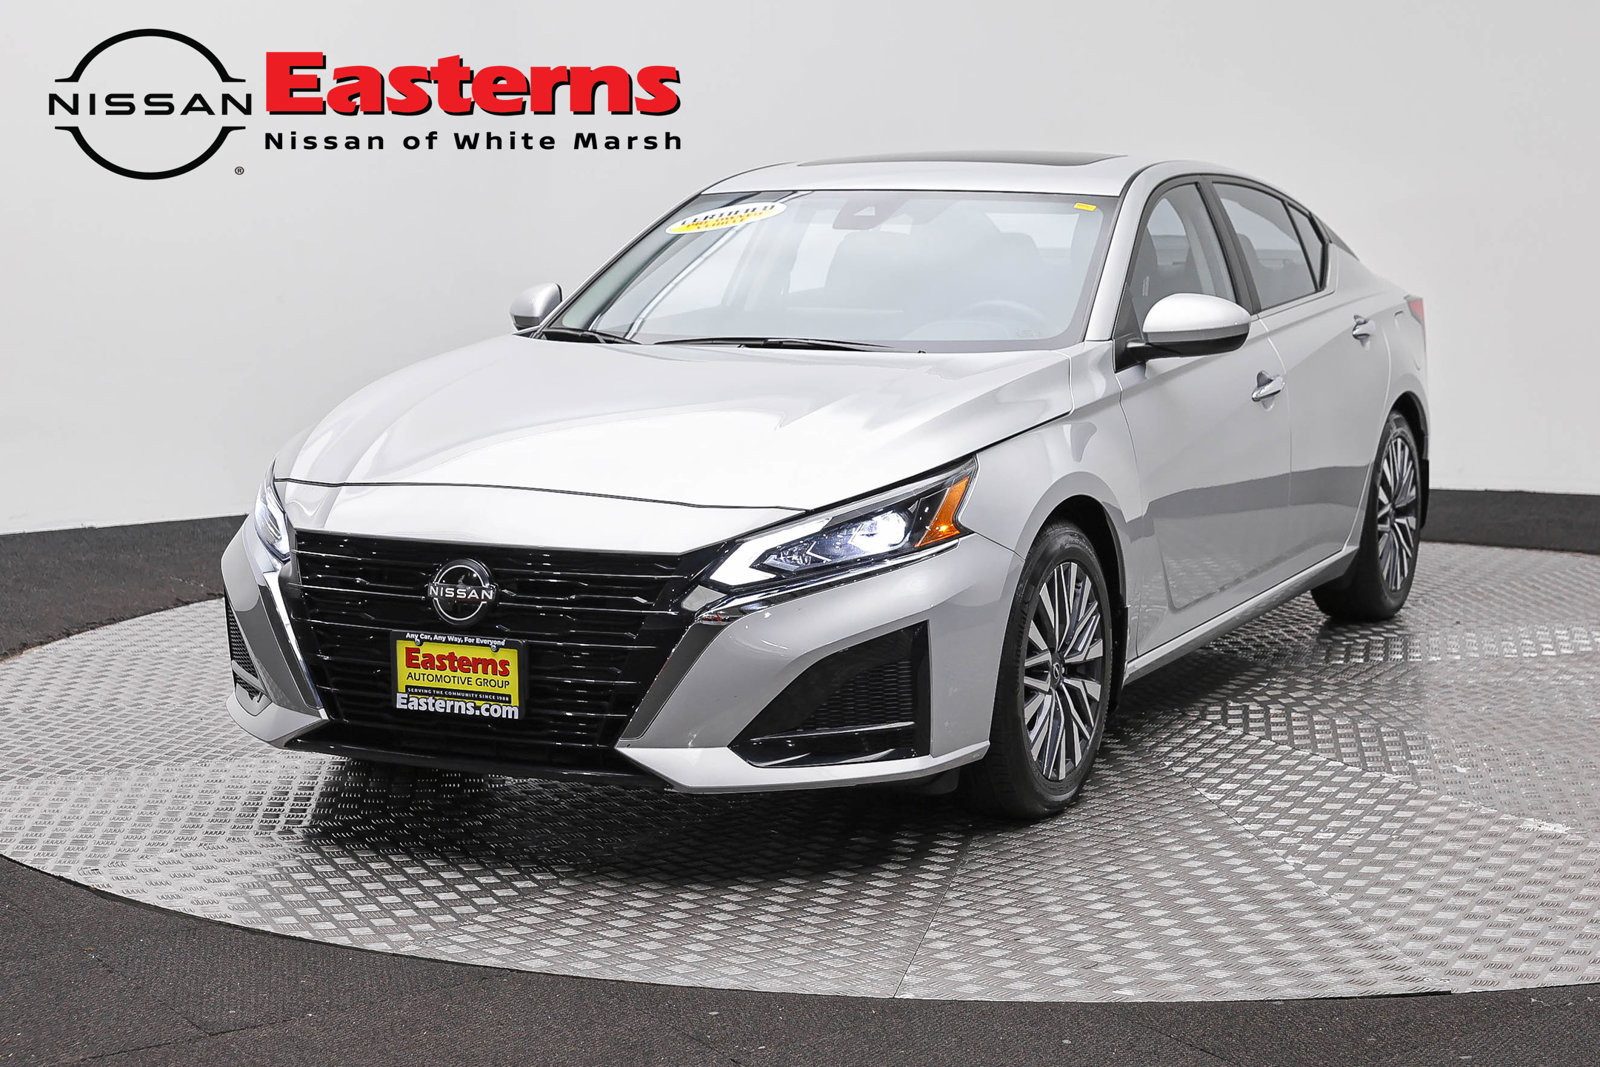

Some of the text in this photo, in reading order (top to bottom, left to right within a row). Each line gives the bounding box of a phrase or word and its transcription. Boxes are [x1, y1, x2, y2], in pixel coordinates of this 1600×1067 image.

[429, 585, 494, 600] NISSAN
[406, 632, 419, 642] Any
[420, 633, 433, 641] Car,
[433, 634, 446, 642] Any
[447, 635, 464, 644] Way,
[405, 646, 510, 677] Easterns
[407, 672, 510, 689] AUTOMOTIVE GROUP
[396, 693, 519, 720] Easterns.com
